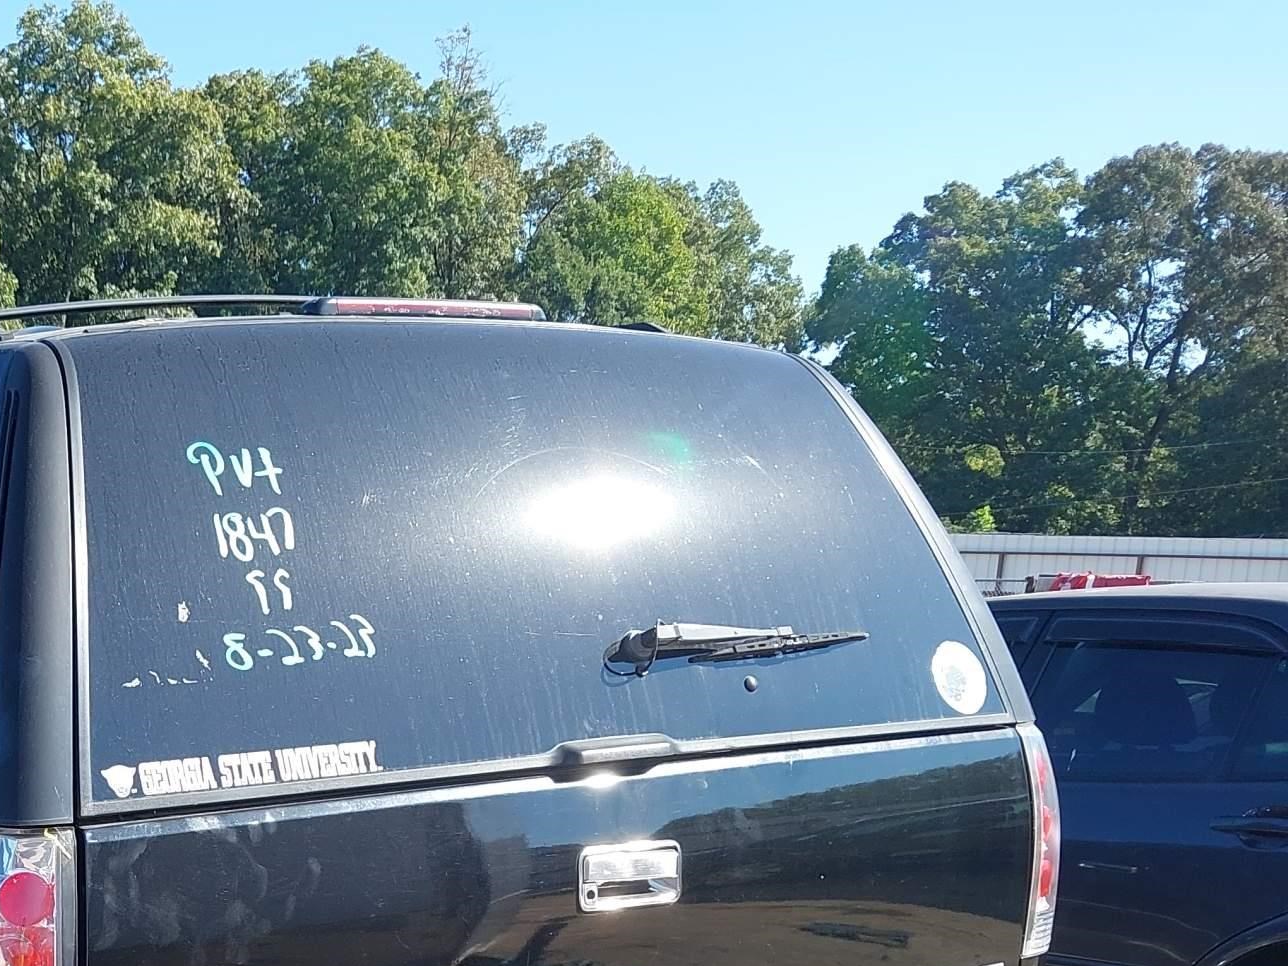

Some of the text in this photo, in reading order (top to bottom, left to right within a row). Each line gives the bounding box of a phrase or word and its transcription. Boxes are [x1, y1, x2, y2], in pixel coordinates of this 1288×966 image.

[213, 506, 296, 562] 1847
[223, 614, 376, 671] 8-23-23
[137, 740, 380, 796] GEORGIA STATE UNIVERSITY
